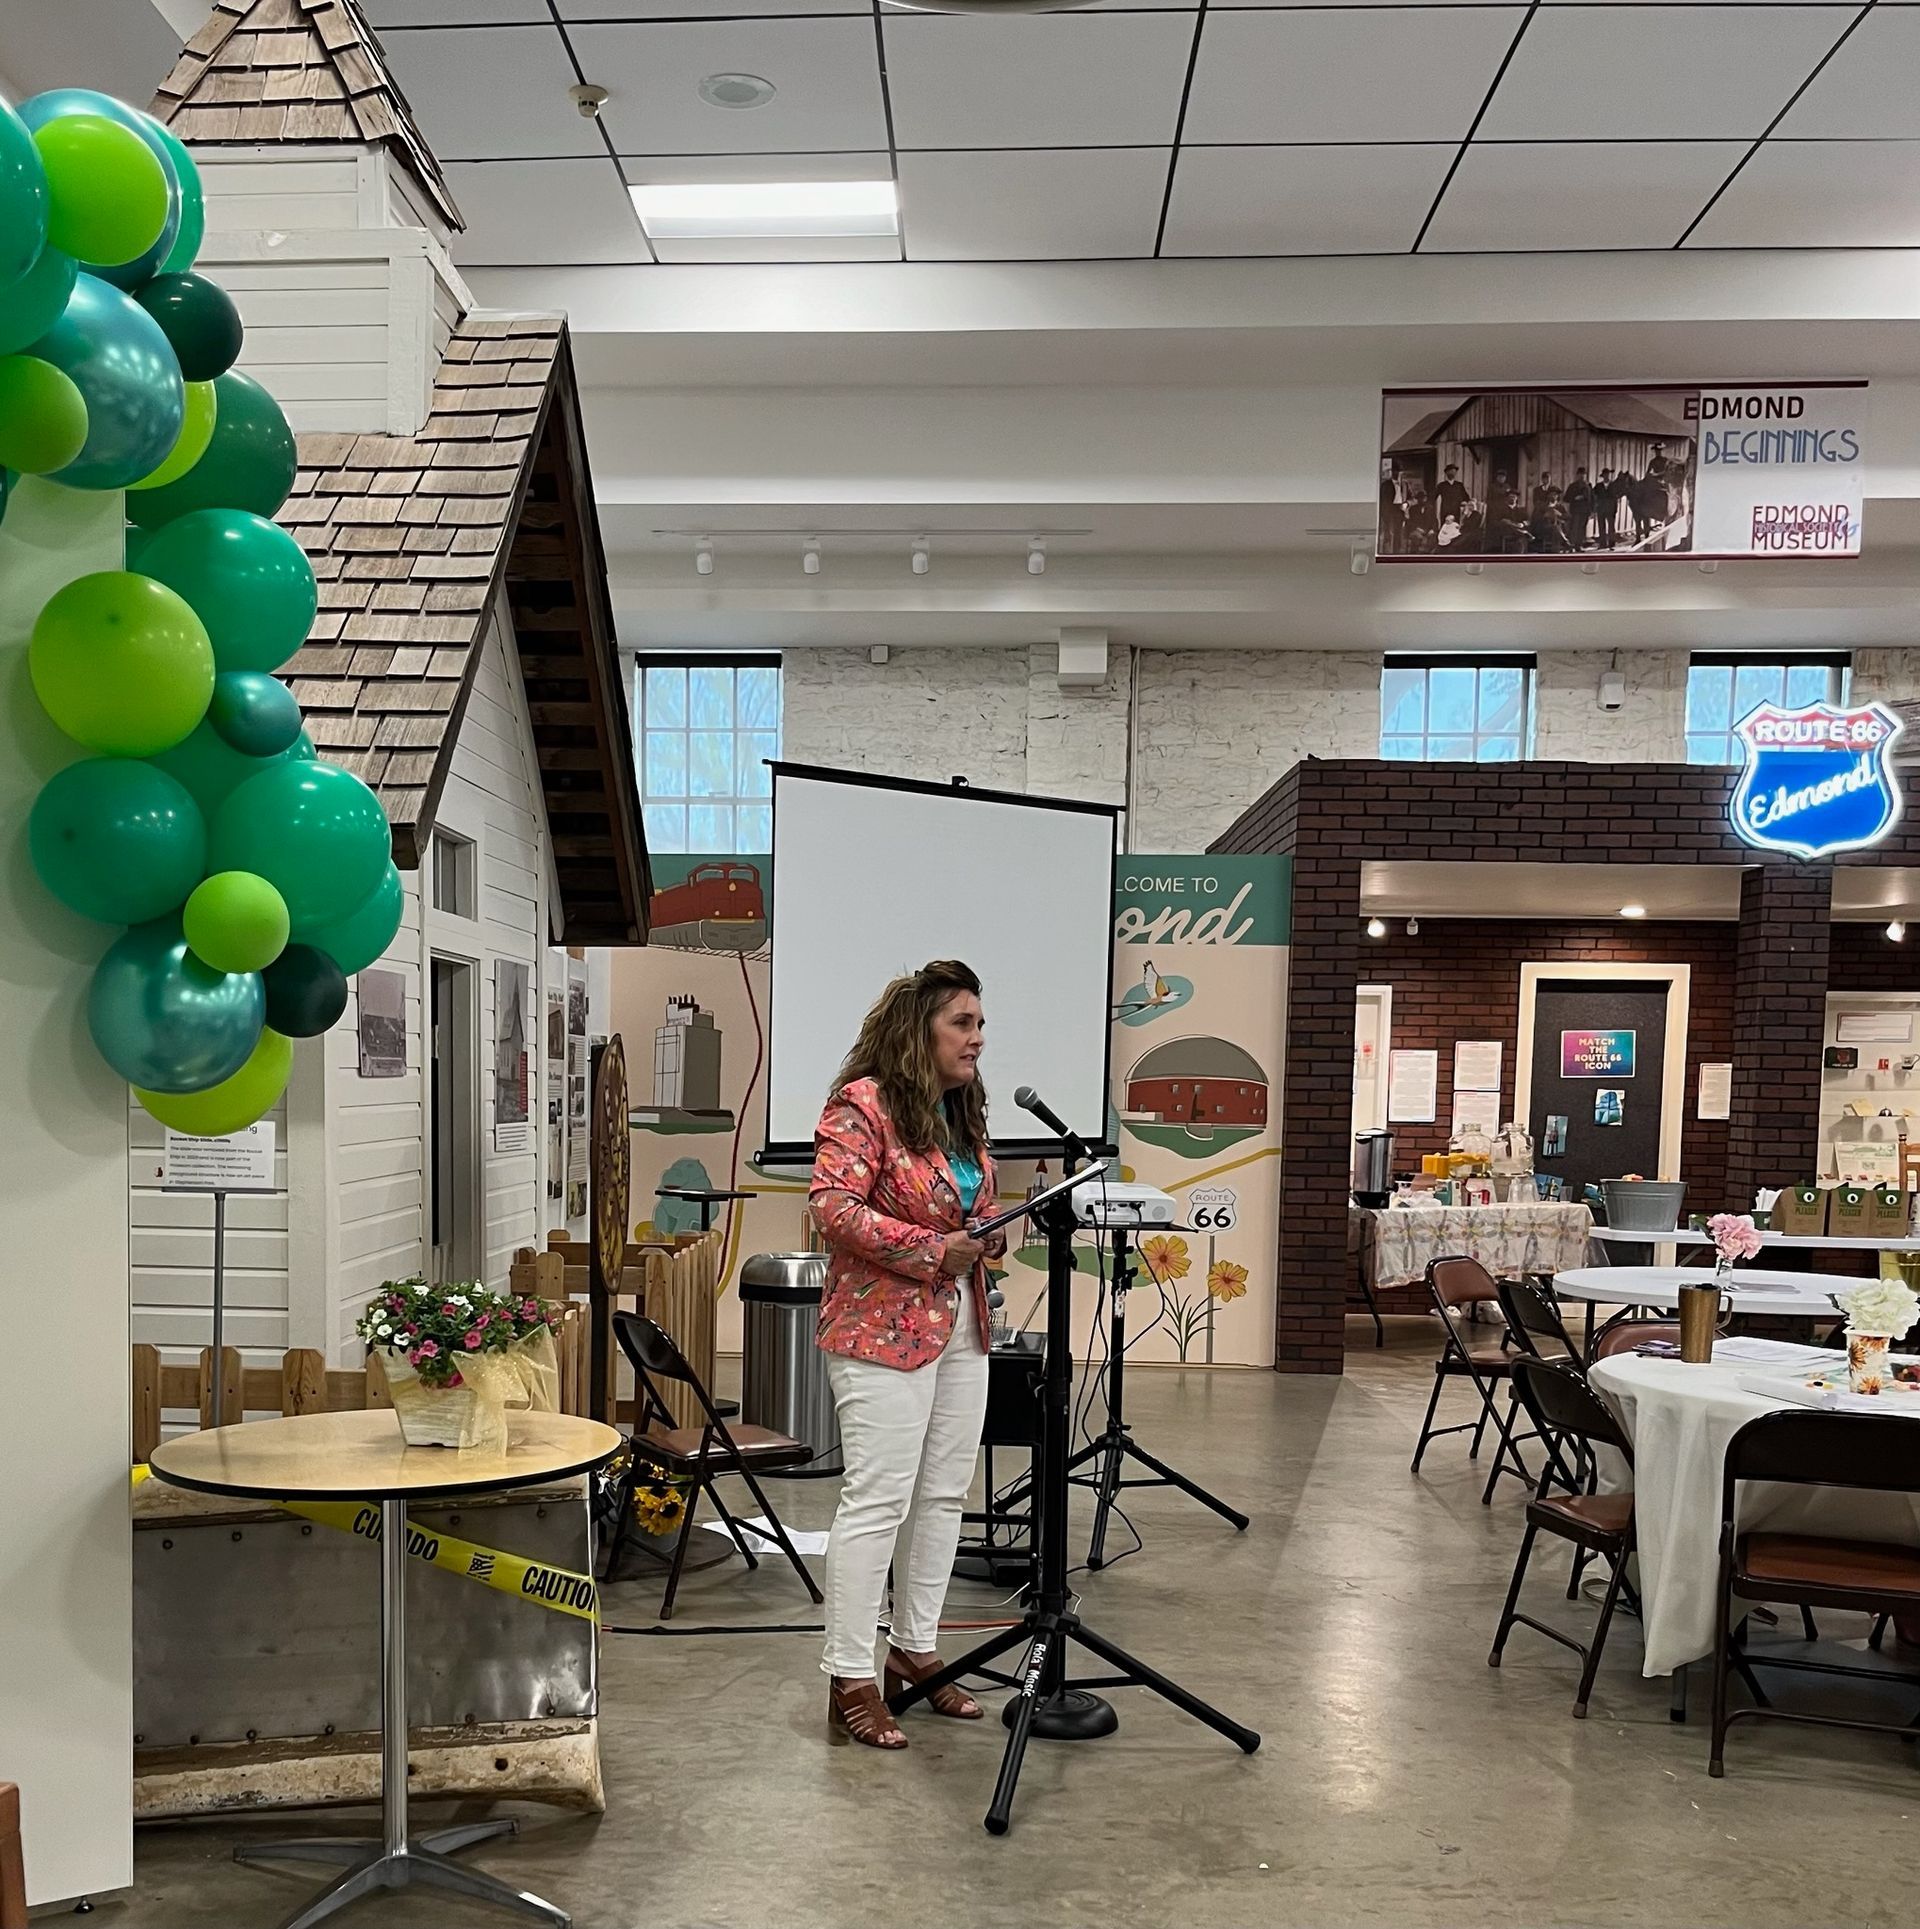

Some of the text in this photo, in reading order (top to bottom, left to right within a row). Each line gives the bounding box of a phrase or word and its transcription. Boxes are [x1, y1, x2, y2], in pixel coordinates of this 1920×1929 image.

[1683, 396, 1804, 420] EDMOND
[1704, 429, 1860, 464] BEGINNINGS
[1752, 505, 1849, 523] EDMOND
[1751, 529, 1849, 550] MUSEUM
[1755, 720, 1882, 743] ROUTE 66
[1749, 752, 1878, 828] Edmond
[1115, 877, 1219, 893] COME TO
[1115, 882, 1254, 946] ond
[1574, 1054, 1608, 1062] ROUTE
[1584, 1062, 1611, 1070] ICON
[1194, 1207, 1231, 1228] 66
[352, 1508, 439, 1561] CUDO
